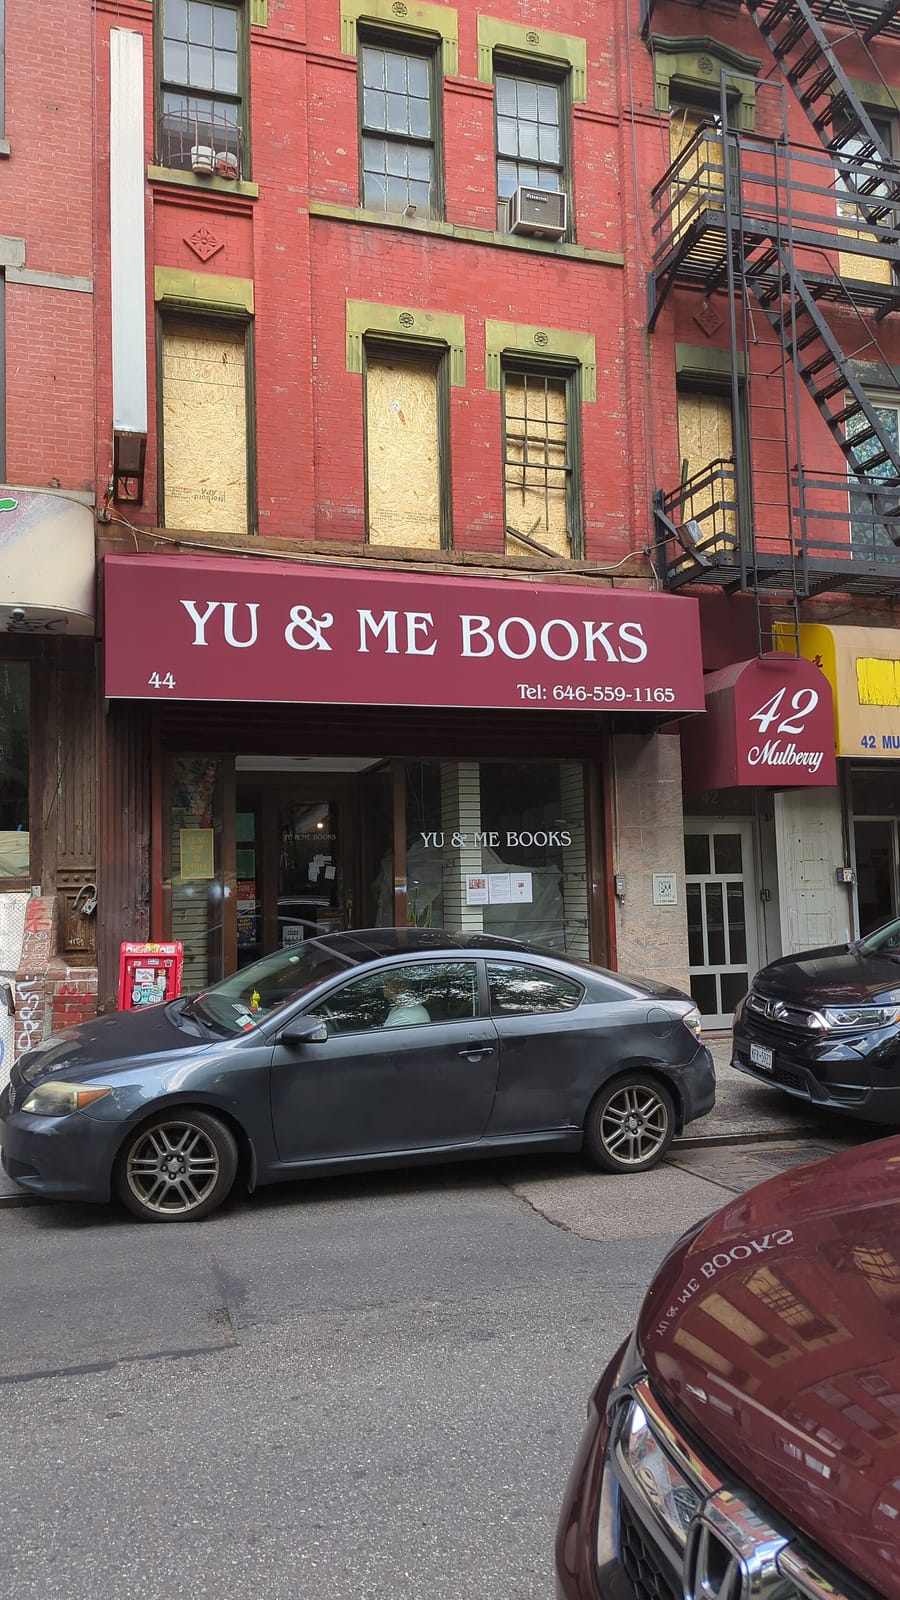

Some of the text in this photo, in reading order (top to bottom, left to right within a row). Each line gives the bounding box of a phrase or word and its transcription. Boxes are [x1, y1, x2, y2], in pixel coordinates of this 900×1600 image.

[180, 599, 648, 664] YU & ME BOOKS
[148, 671, 176, 689] 44
[517, 683, 676, 703] Tel: 646-559-1165
[749, 687, 819, 734] 42
[860, 735, 877, 749] 42
[747, 739, 824, 773] Mulberry
[420, 831, 572, 848] YU & ME BOOKS
